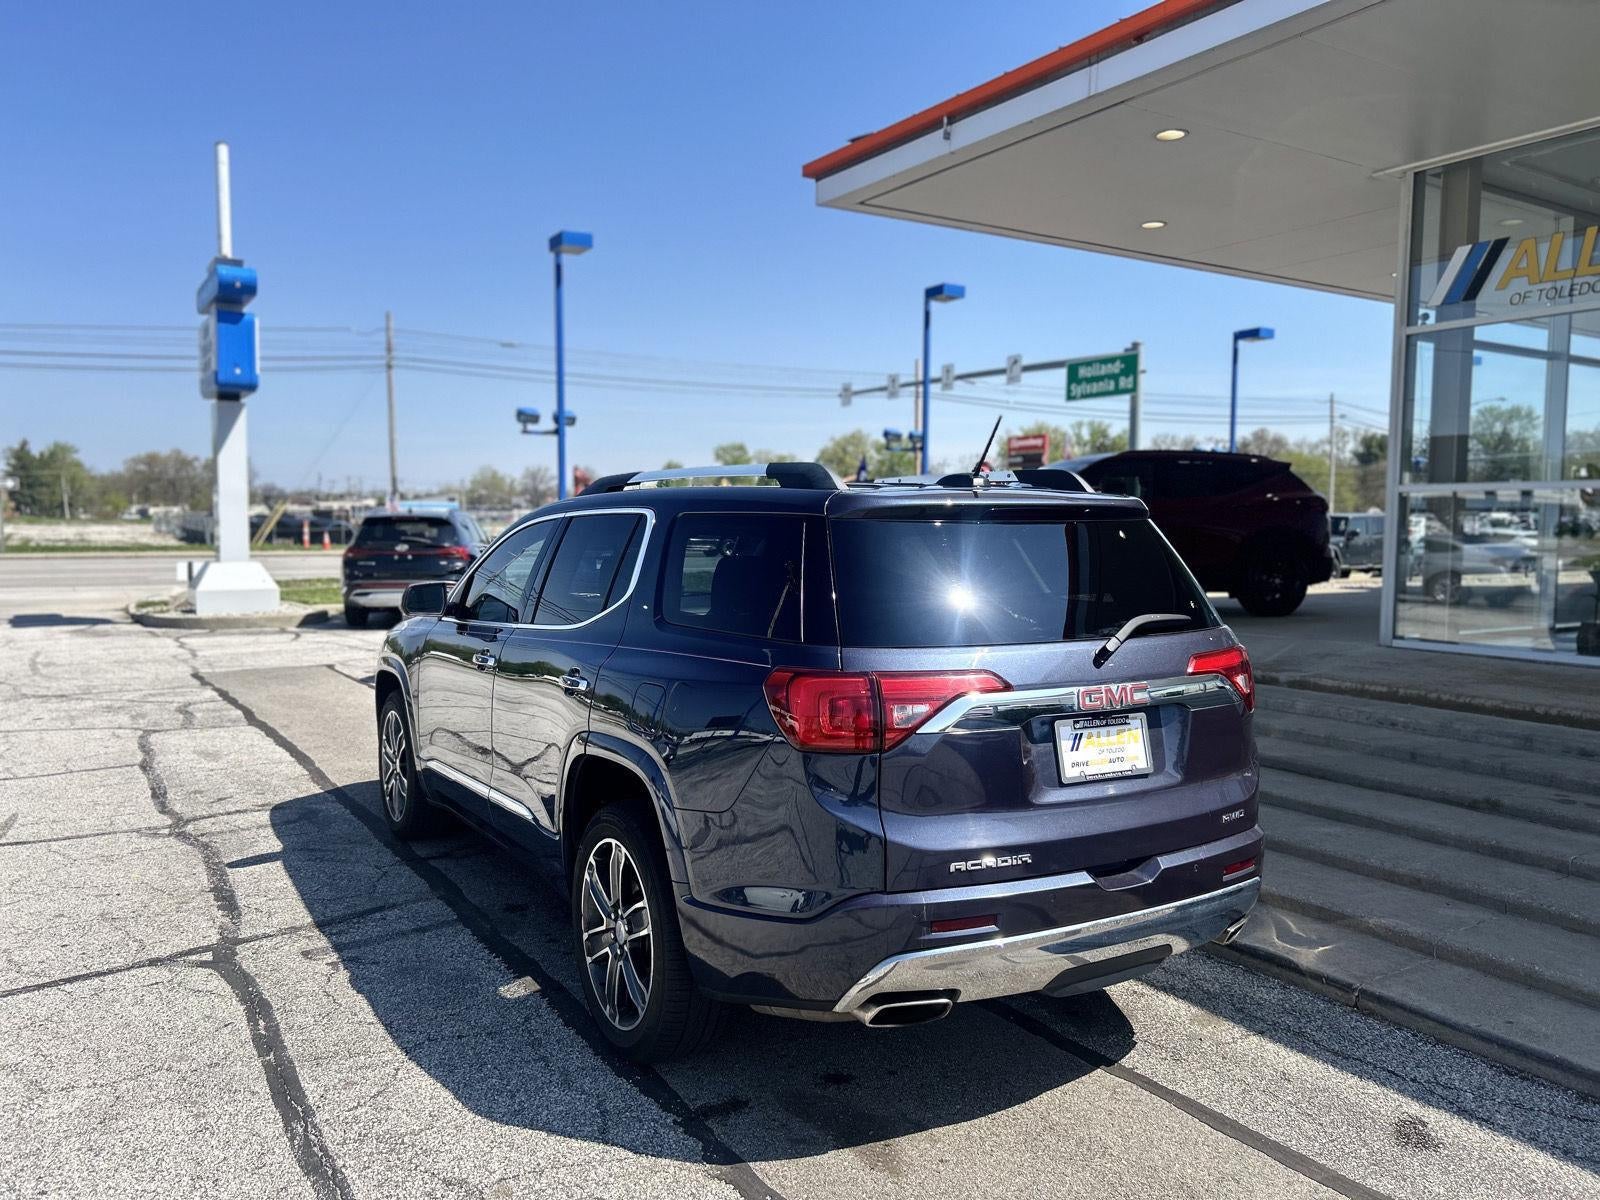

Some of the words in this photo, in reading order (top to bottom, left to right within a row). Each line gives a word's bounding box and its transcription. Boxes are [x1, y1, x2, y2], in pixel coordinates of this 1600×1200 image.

[1509, 291, 1534, 306] OF
[1078, 360, 1125, 379] Holland-
[1070, 379, 1115, 398] Sylvania
[1118, 375, 1134, 389] Rd
[1079, 682, 1150, 711] GMC
[1084, 719, 1100, 727] ALLEN
[1107, 717, 1125, 725] TOLEDO
[1084, 728, 1139, 748] ALLEN
[949, 853, 1032, 873] ACADIA
